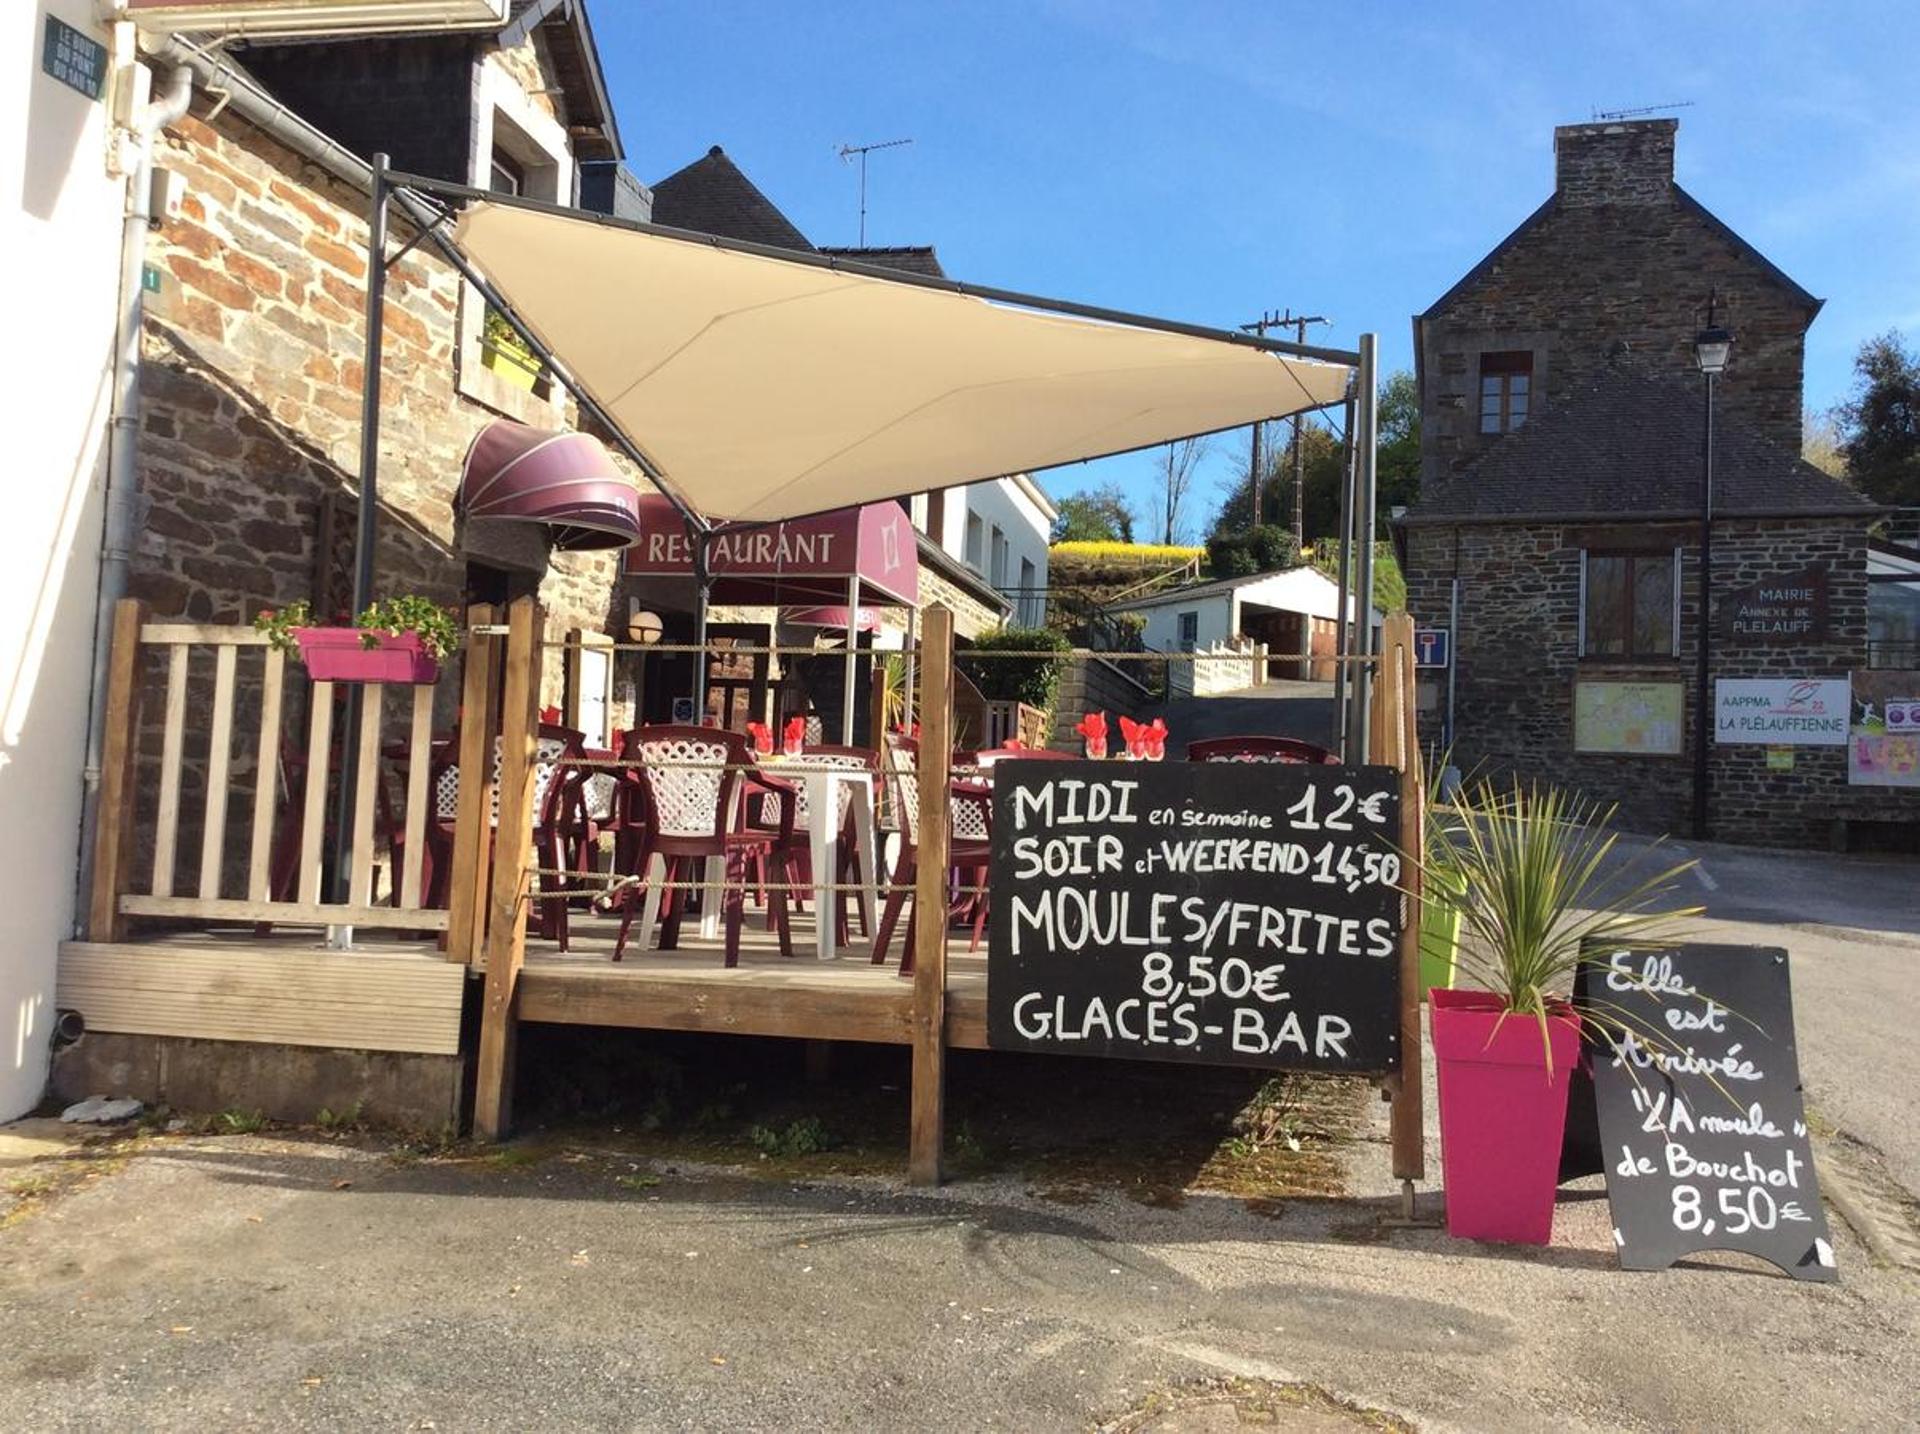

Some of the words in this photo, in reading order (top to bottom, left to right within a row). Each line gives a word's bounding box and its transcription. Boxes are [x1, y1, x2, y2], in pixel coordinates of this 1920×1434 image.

[648, 533, 834, 563] RESAURANT
[1760, 589, 1814, 600] MAIRIE
[1733, 620, 1812, 633] PLELAUFF
[1720, 718, 1735, 730] LA
[1740, 716, 1844, 732] PLÉLAUFFIENNE
[1722, 696, 1771, 707] AAPPMA
[1015, 780, 1138, 829] MIDI
[1148, 808, 1176, 825] en
[1181, 809, 1273, 828] semaine
[1286, 783, 1389, 831] 12€
[1014, 834, 1124, 879] SOIR
[1135, 847, 1163, 874] et
[1160, 838, 1310, 875] WEEK-END
[1011, 886, 1394, 957] MOULES/FRITES
[1142, 952, 1290, 1004] 8,50€
[1607, 951, 1696, 996] Elle
[1665, 1001, 1728, 1033] est
[1616, 1145, 1658, 1177] de
[1666, 1142, 1804, 1188] Bouchot
[1672, 1184, 1812, 1236] 8,50€
